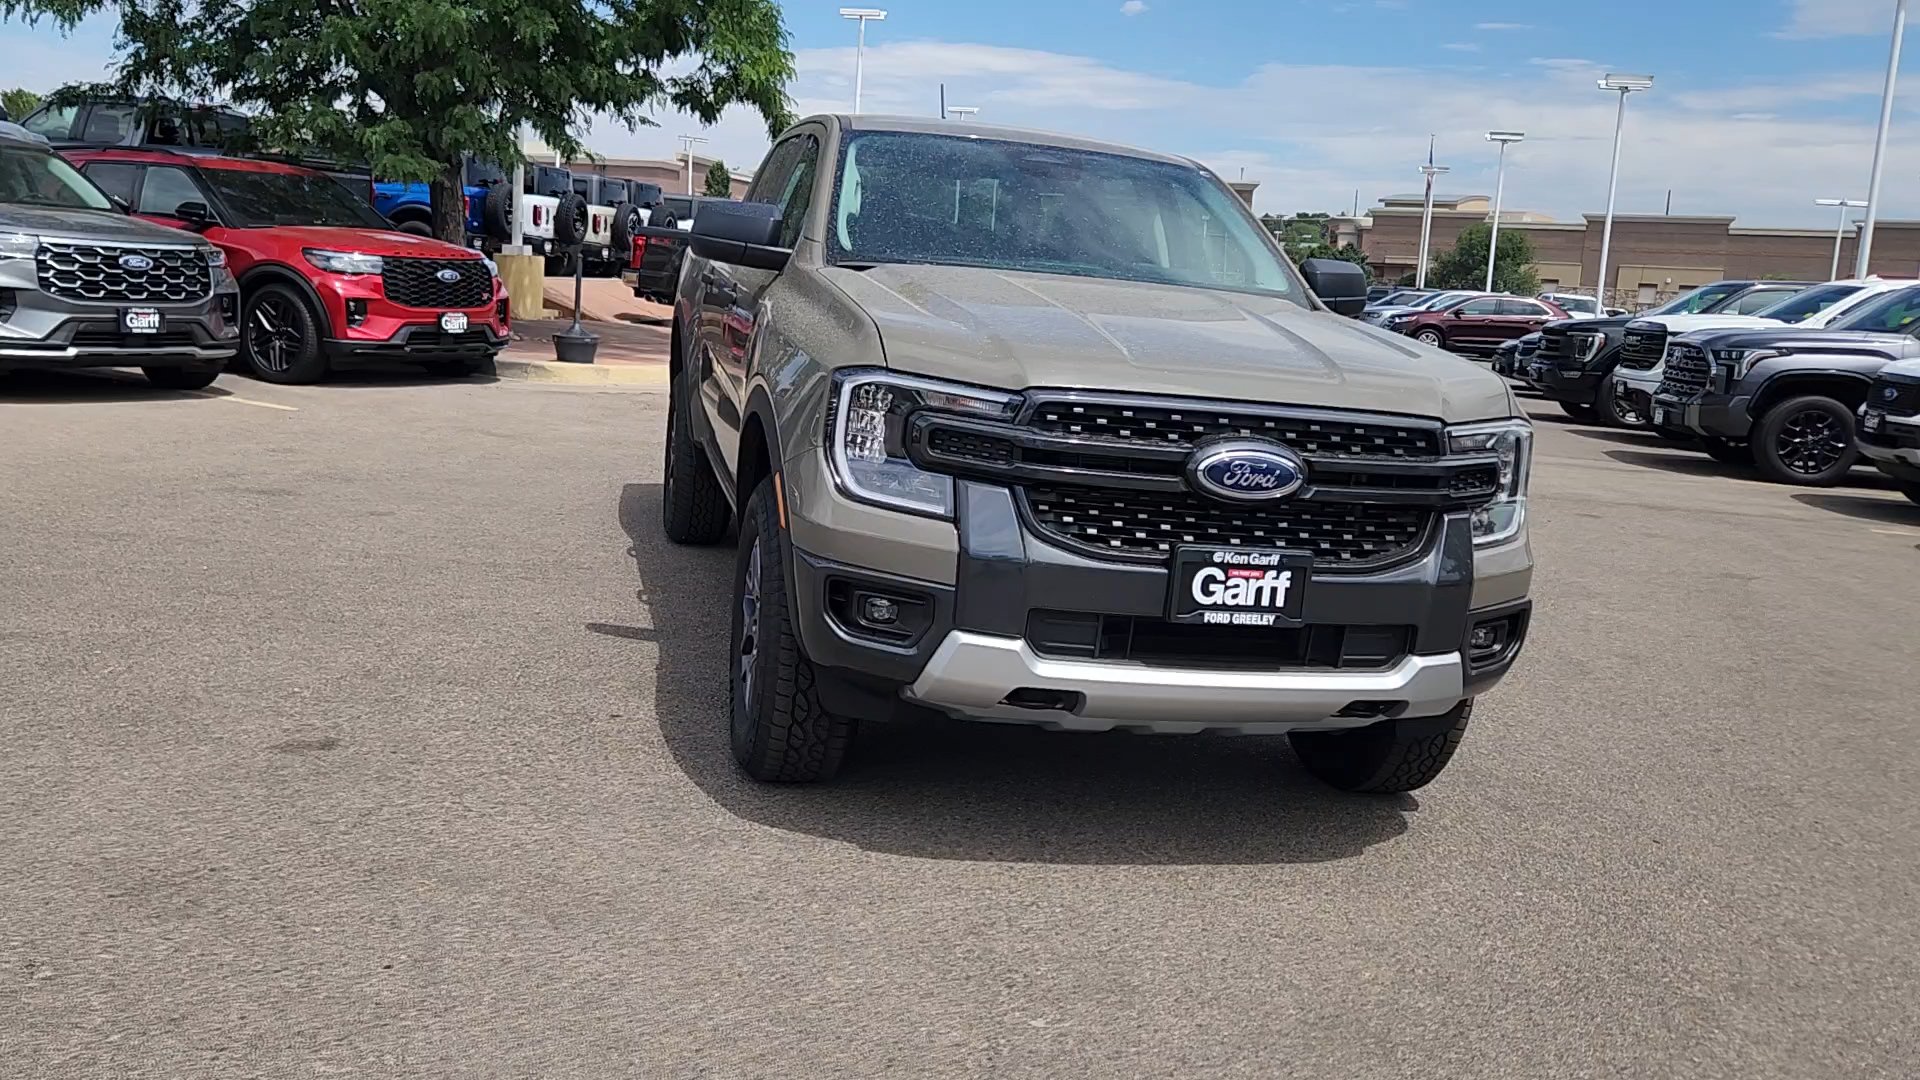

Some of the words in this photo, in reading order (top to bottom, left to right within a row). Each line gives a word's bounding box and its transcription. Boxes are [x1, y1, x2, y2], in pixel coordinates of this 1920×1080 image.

[126, 313, 160, 328] Garff
[1223, 460, 1280, 488] Ford
[1249, 553, 1281, 566] Garff
[1192, 566, 1292, 607] Garff
[1204, 612, 1230, 624] FORD
[1232, 614, 1276, 626] GREELEY
